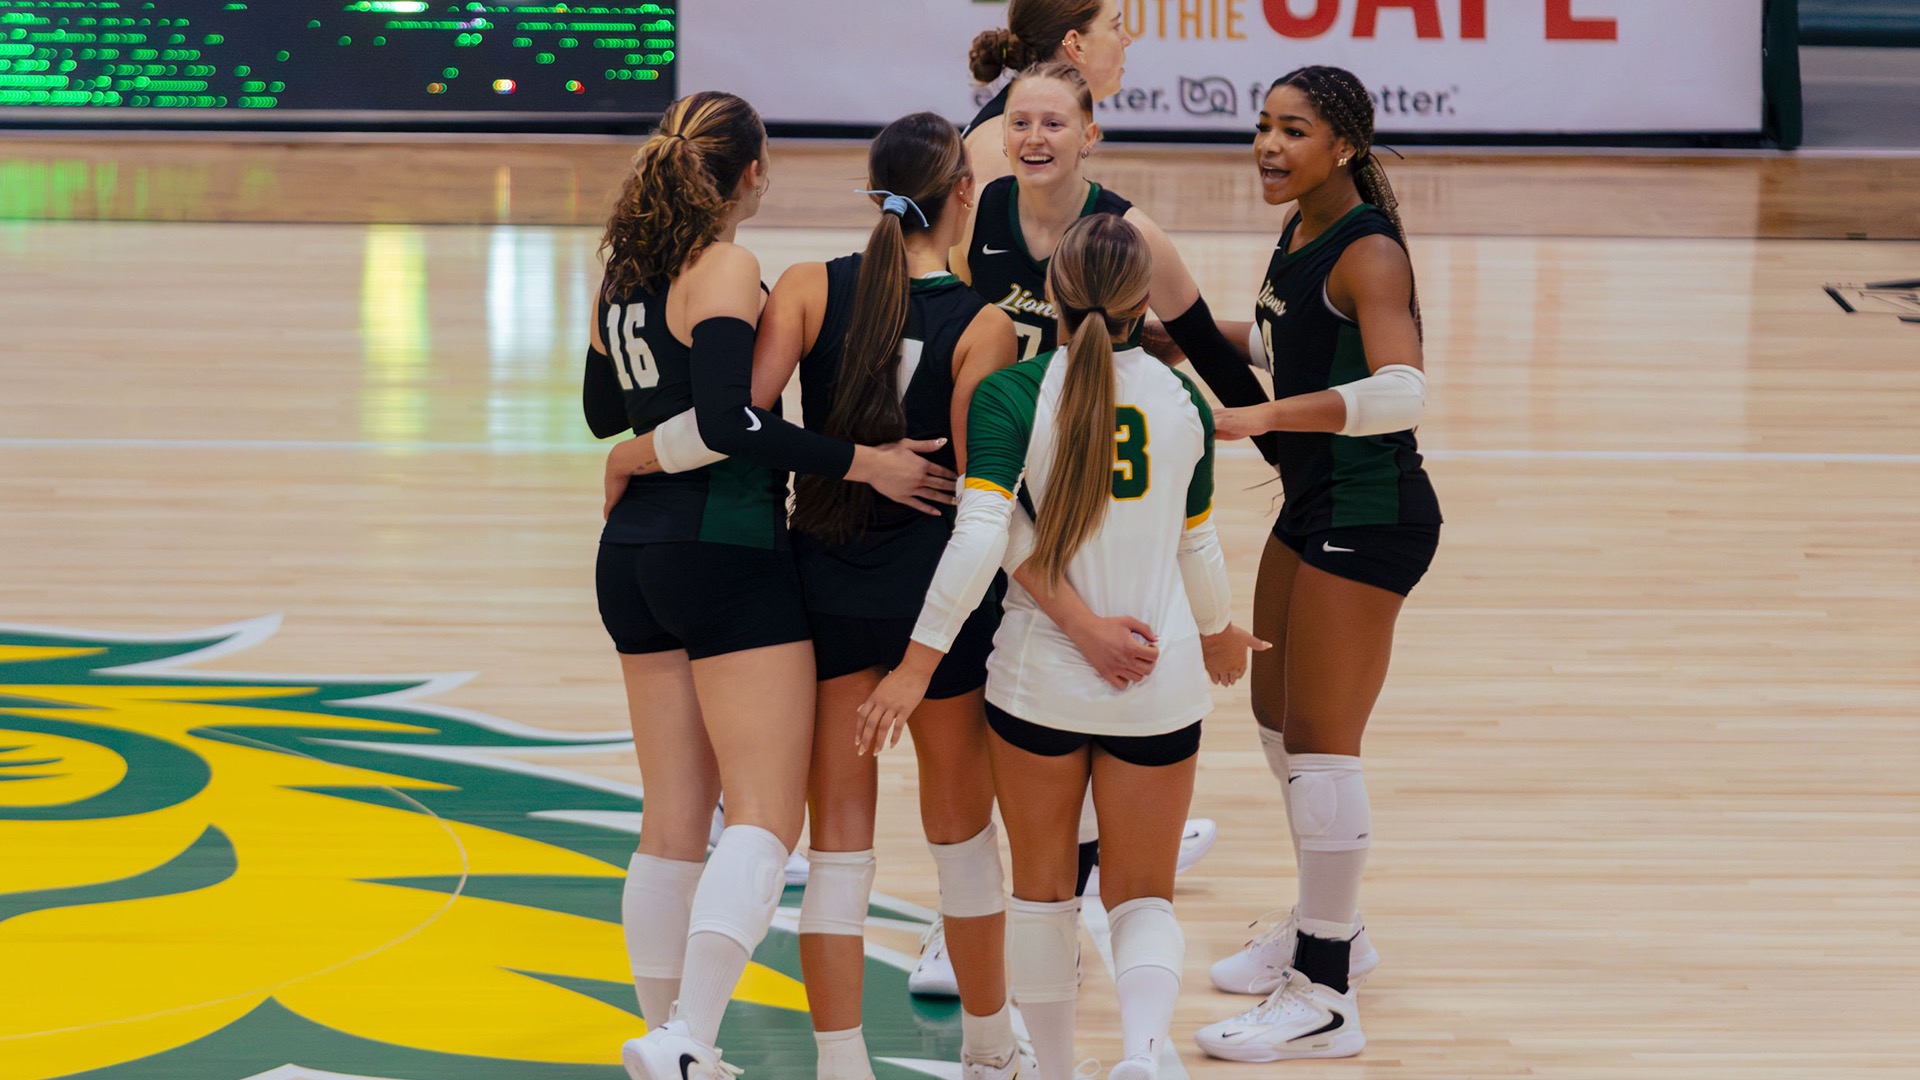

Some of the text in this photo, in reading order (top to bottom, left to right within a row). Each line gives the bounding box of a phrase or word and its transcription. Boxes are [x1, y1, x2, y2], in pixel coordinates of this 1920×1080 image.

[994, 282, 1059, 319] Lion
[606, 302, 660, 390] 16
[1110, 403, 1152, 502] 3
